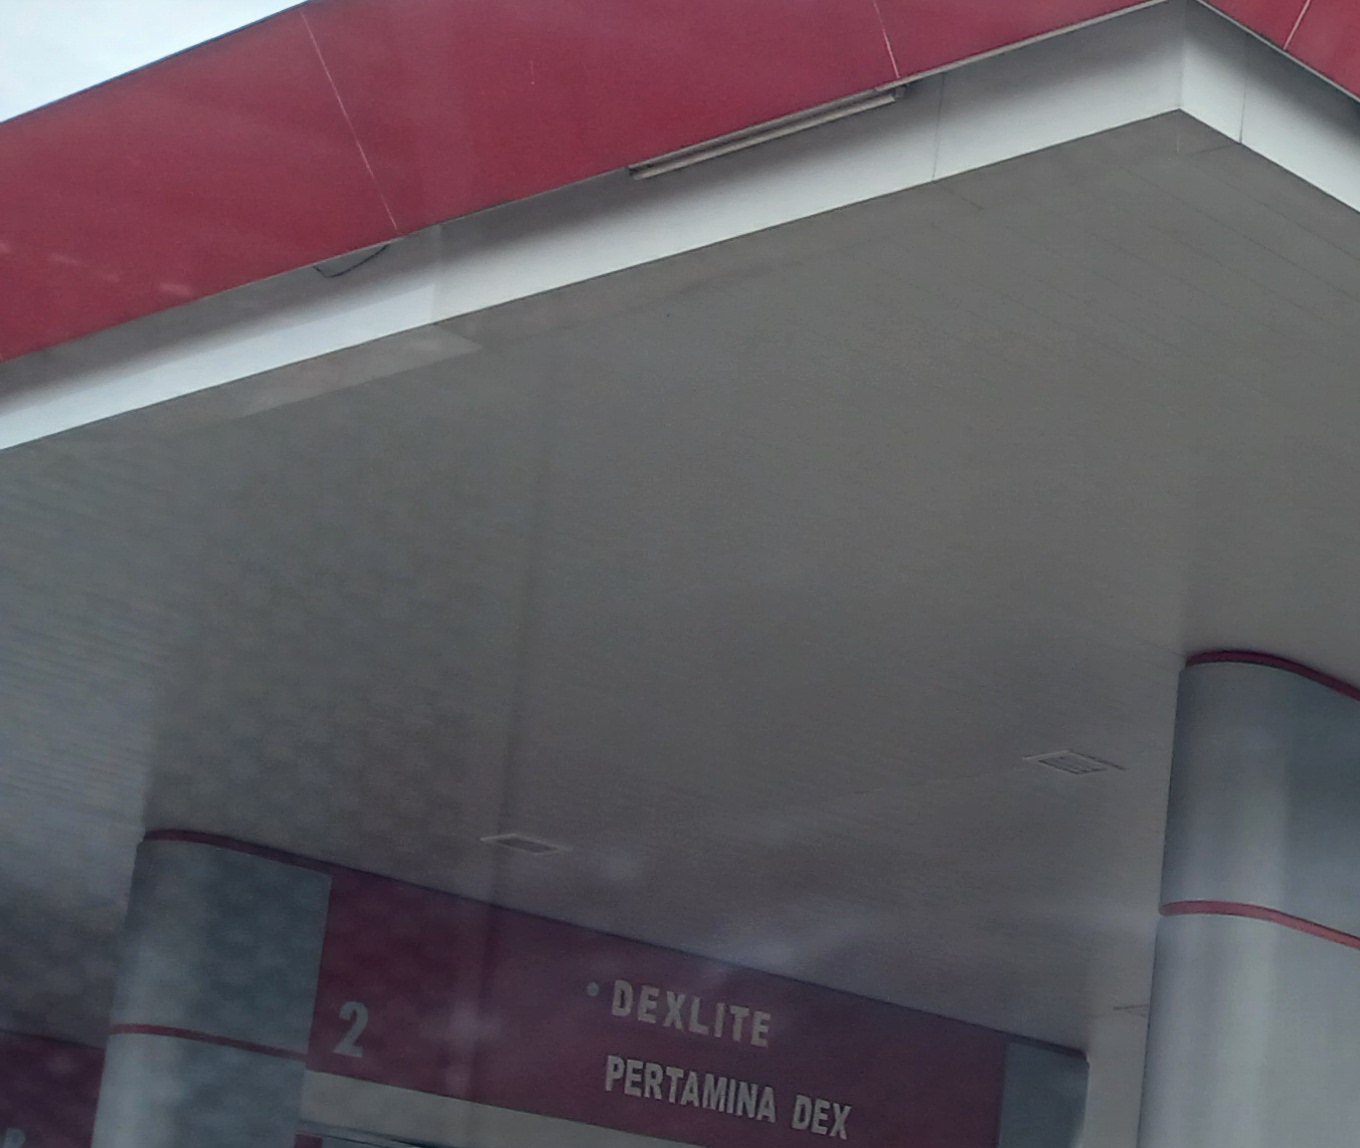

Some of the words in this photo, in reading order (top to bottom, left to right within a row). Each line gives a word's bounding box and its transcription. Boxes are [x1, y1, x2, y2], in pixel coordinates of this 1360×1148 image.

[334, 1001, 369, 1057] 2
[611, 980, 772, 1048] DEXLITE
[605, 1055, 777, 1123] PERTAMINA
[791, 1094, 852, 1140] DEX
